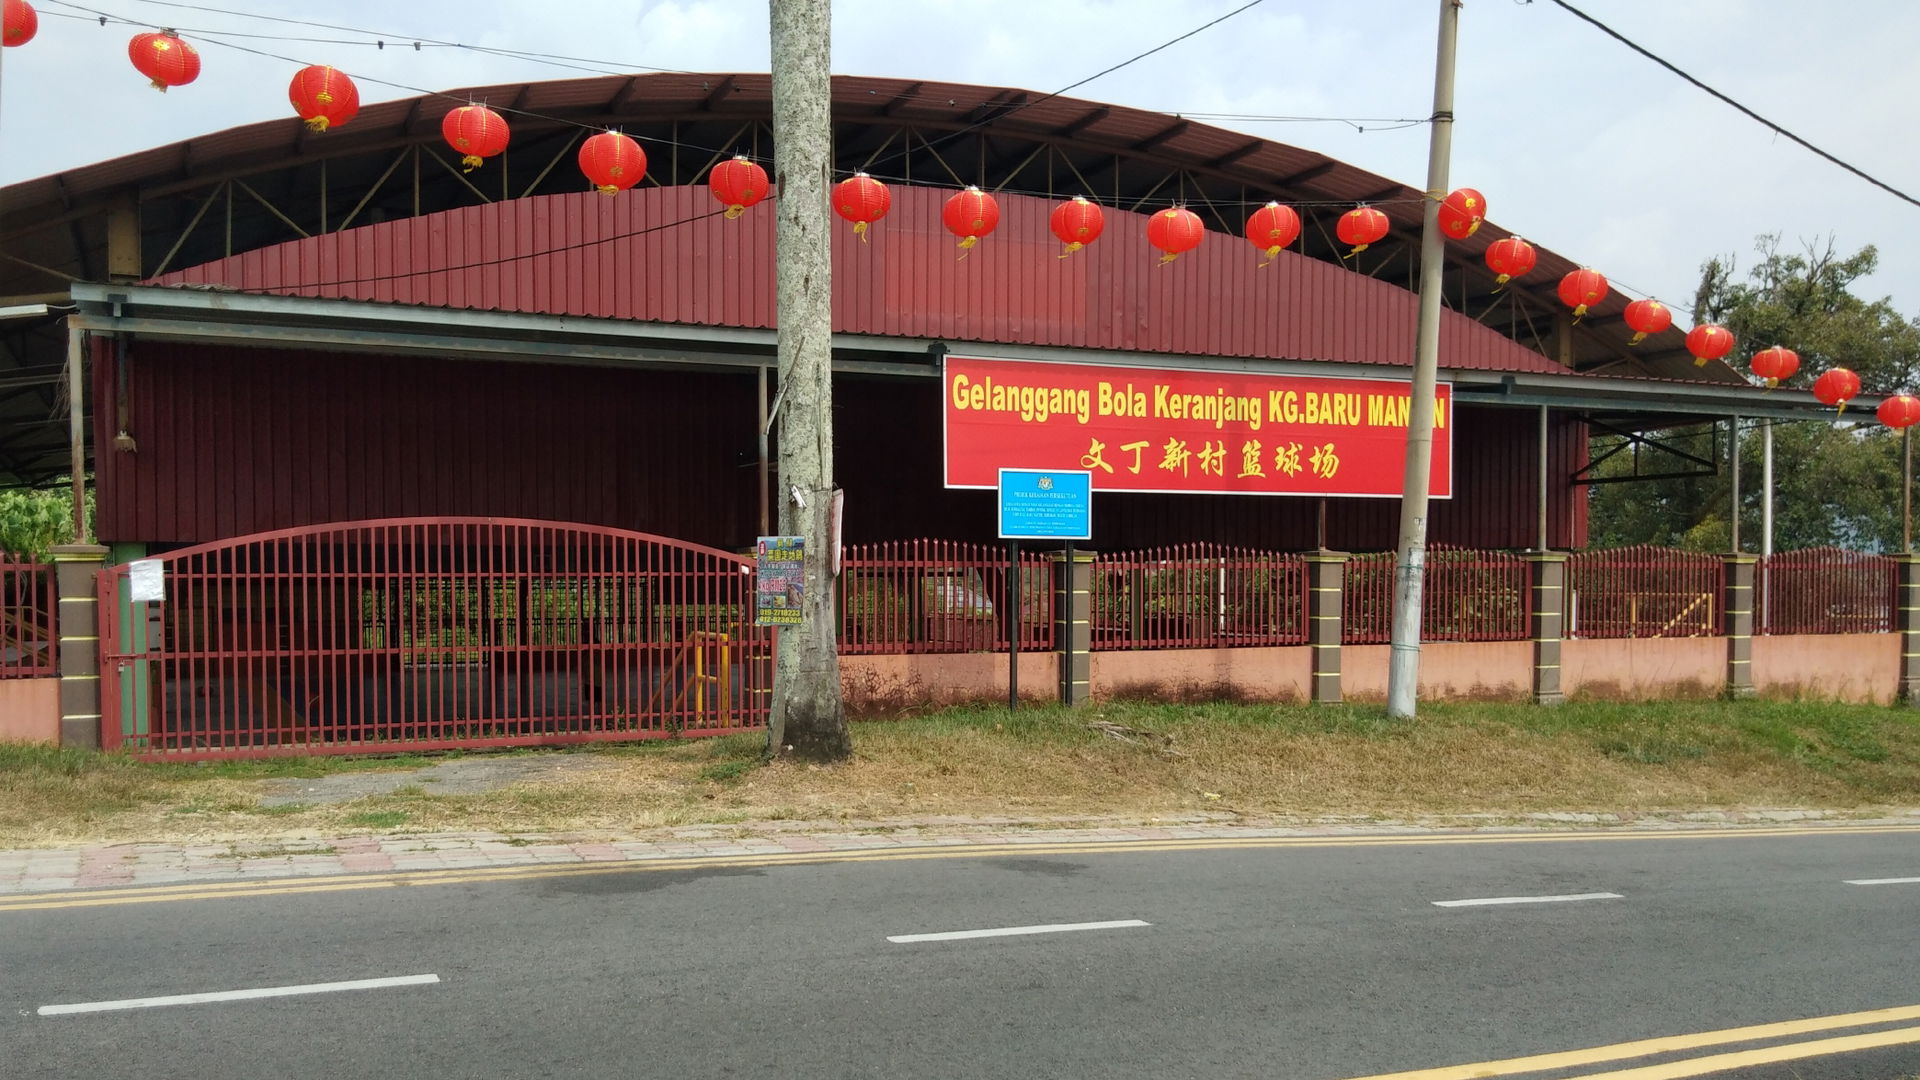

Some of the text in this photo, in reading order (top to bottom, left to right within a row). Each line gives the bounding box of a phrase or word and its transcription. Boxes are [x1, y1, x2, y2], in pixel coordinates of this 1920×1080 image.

[952, 374, 1445, 431] Gelanggang Bola Keranjang KG.BARU MANN
[1079, 436, 1341, 479] 文丁新村篮球场
